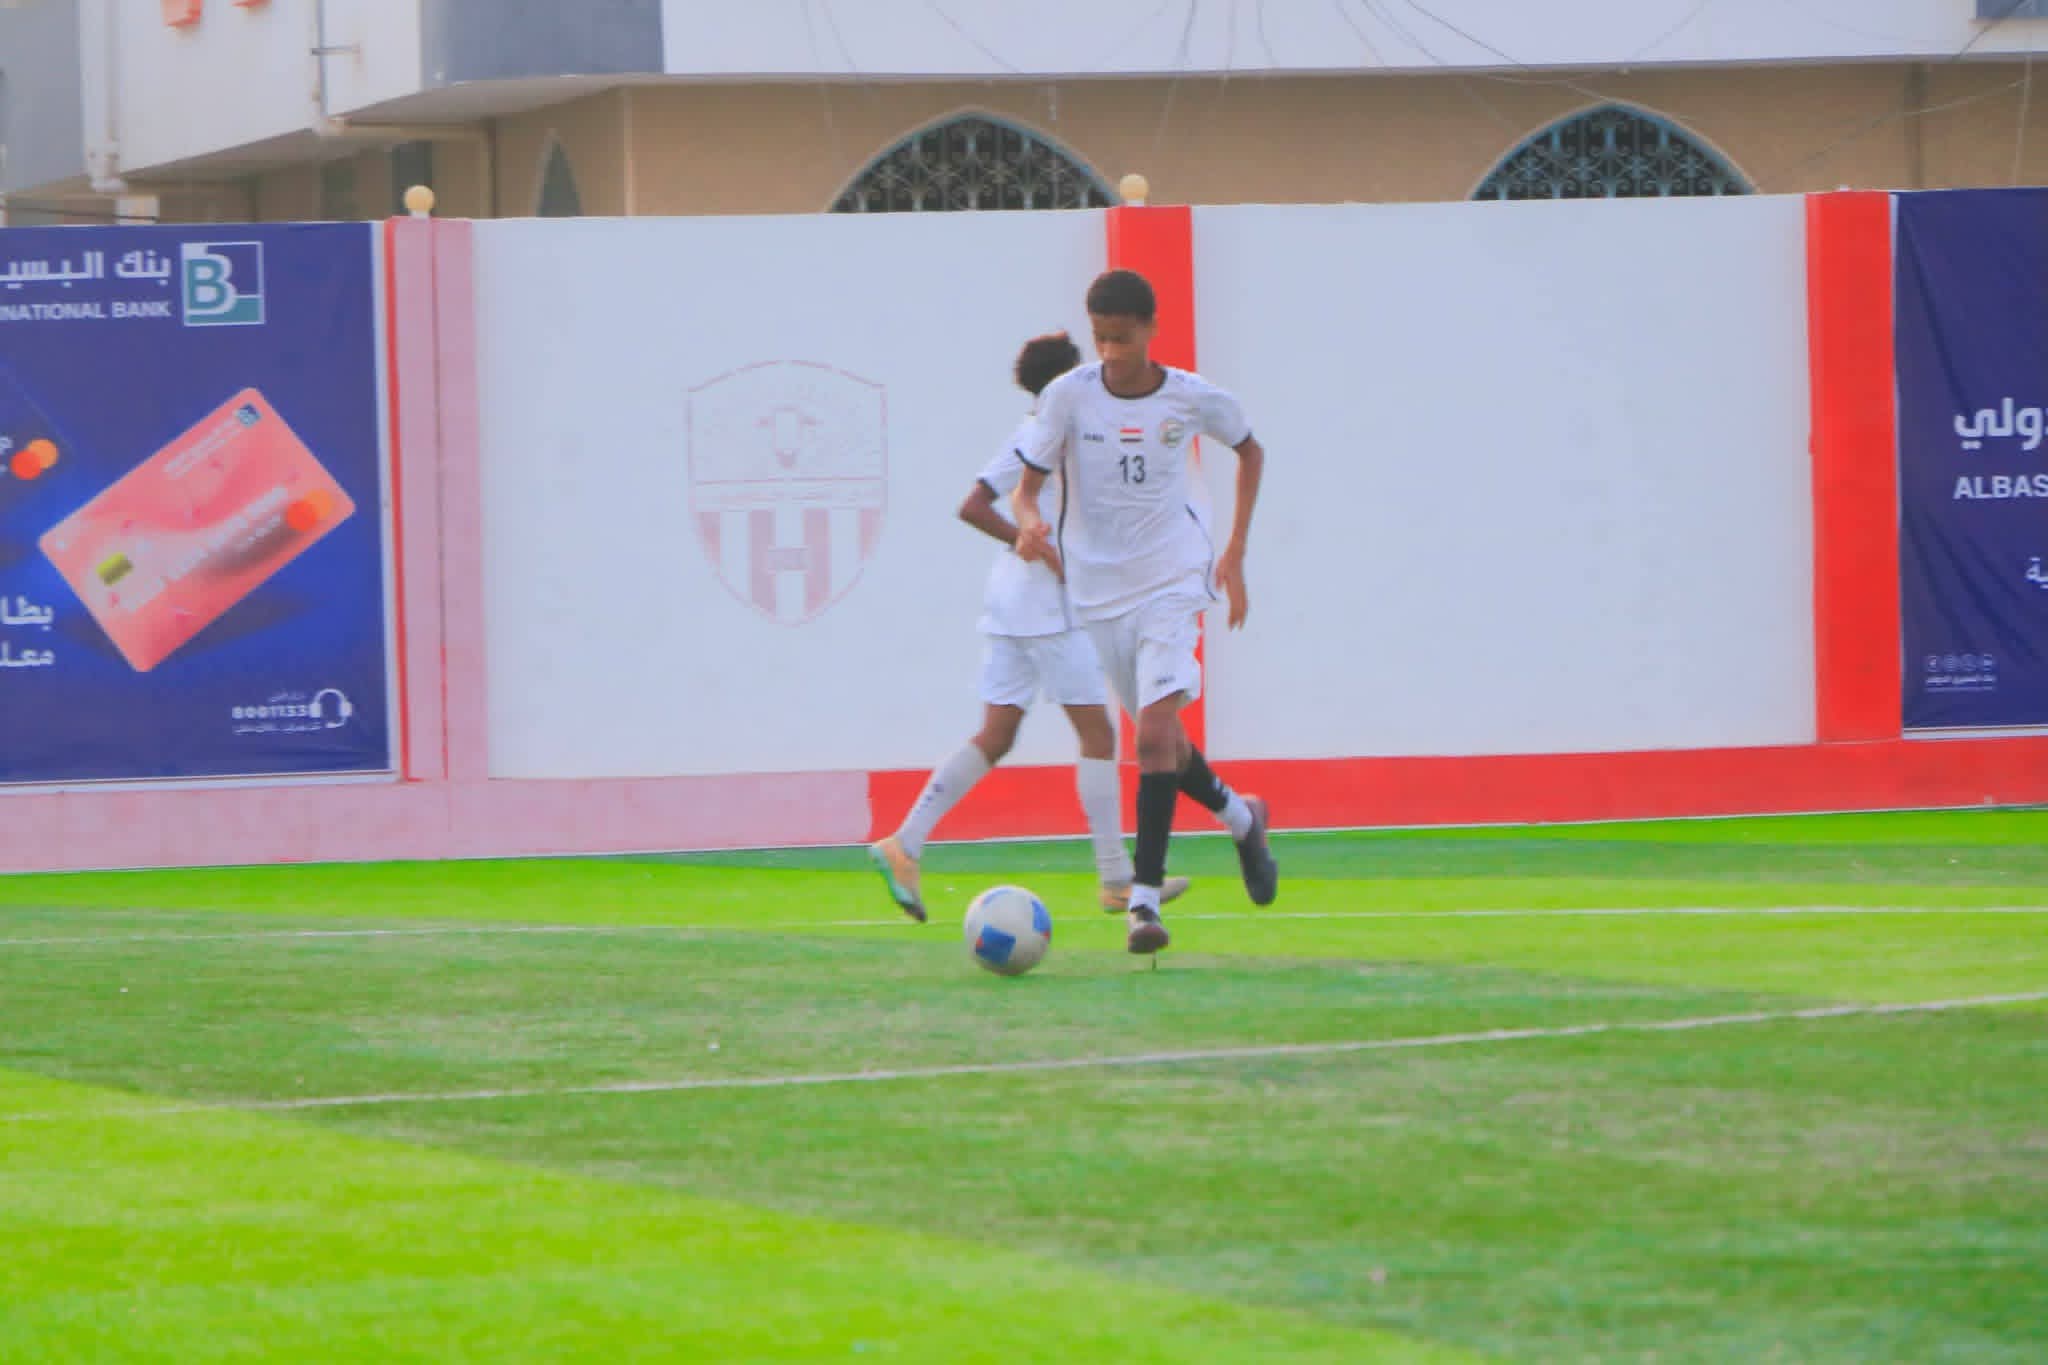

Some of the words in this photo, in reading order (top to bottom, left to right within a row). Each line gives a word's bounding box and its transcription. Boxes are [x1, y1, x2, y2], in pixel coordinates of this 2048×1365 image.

[114, 250, 171, 286] بنك
[111, 301, 172, 319] BANK
[1953, 397, 2048, 450] ولي
[1119, 455, 1146, 484] 13
[1953, 474, 2048, 499] ALBAS
